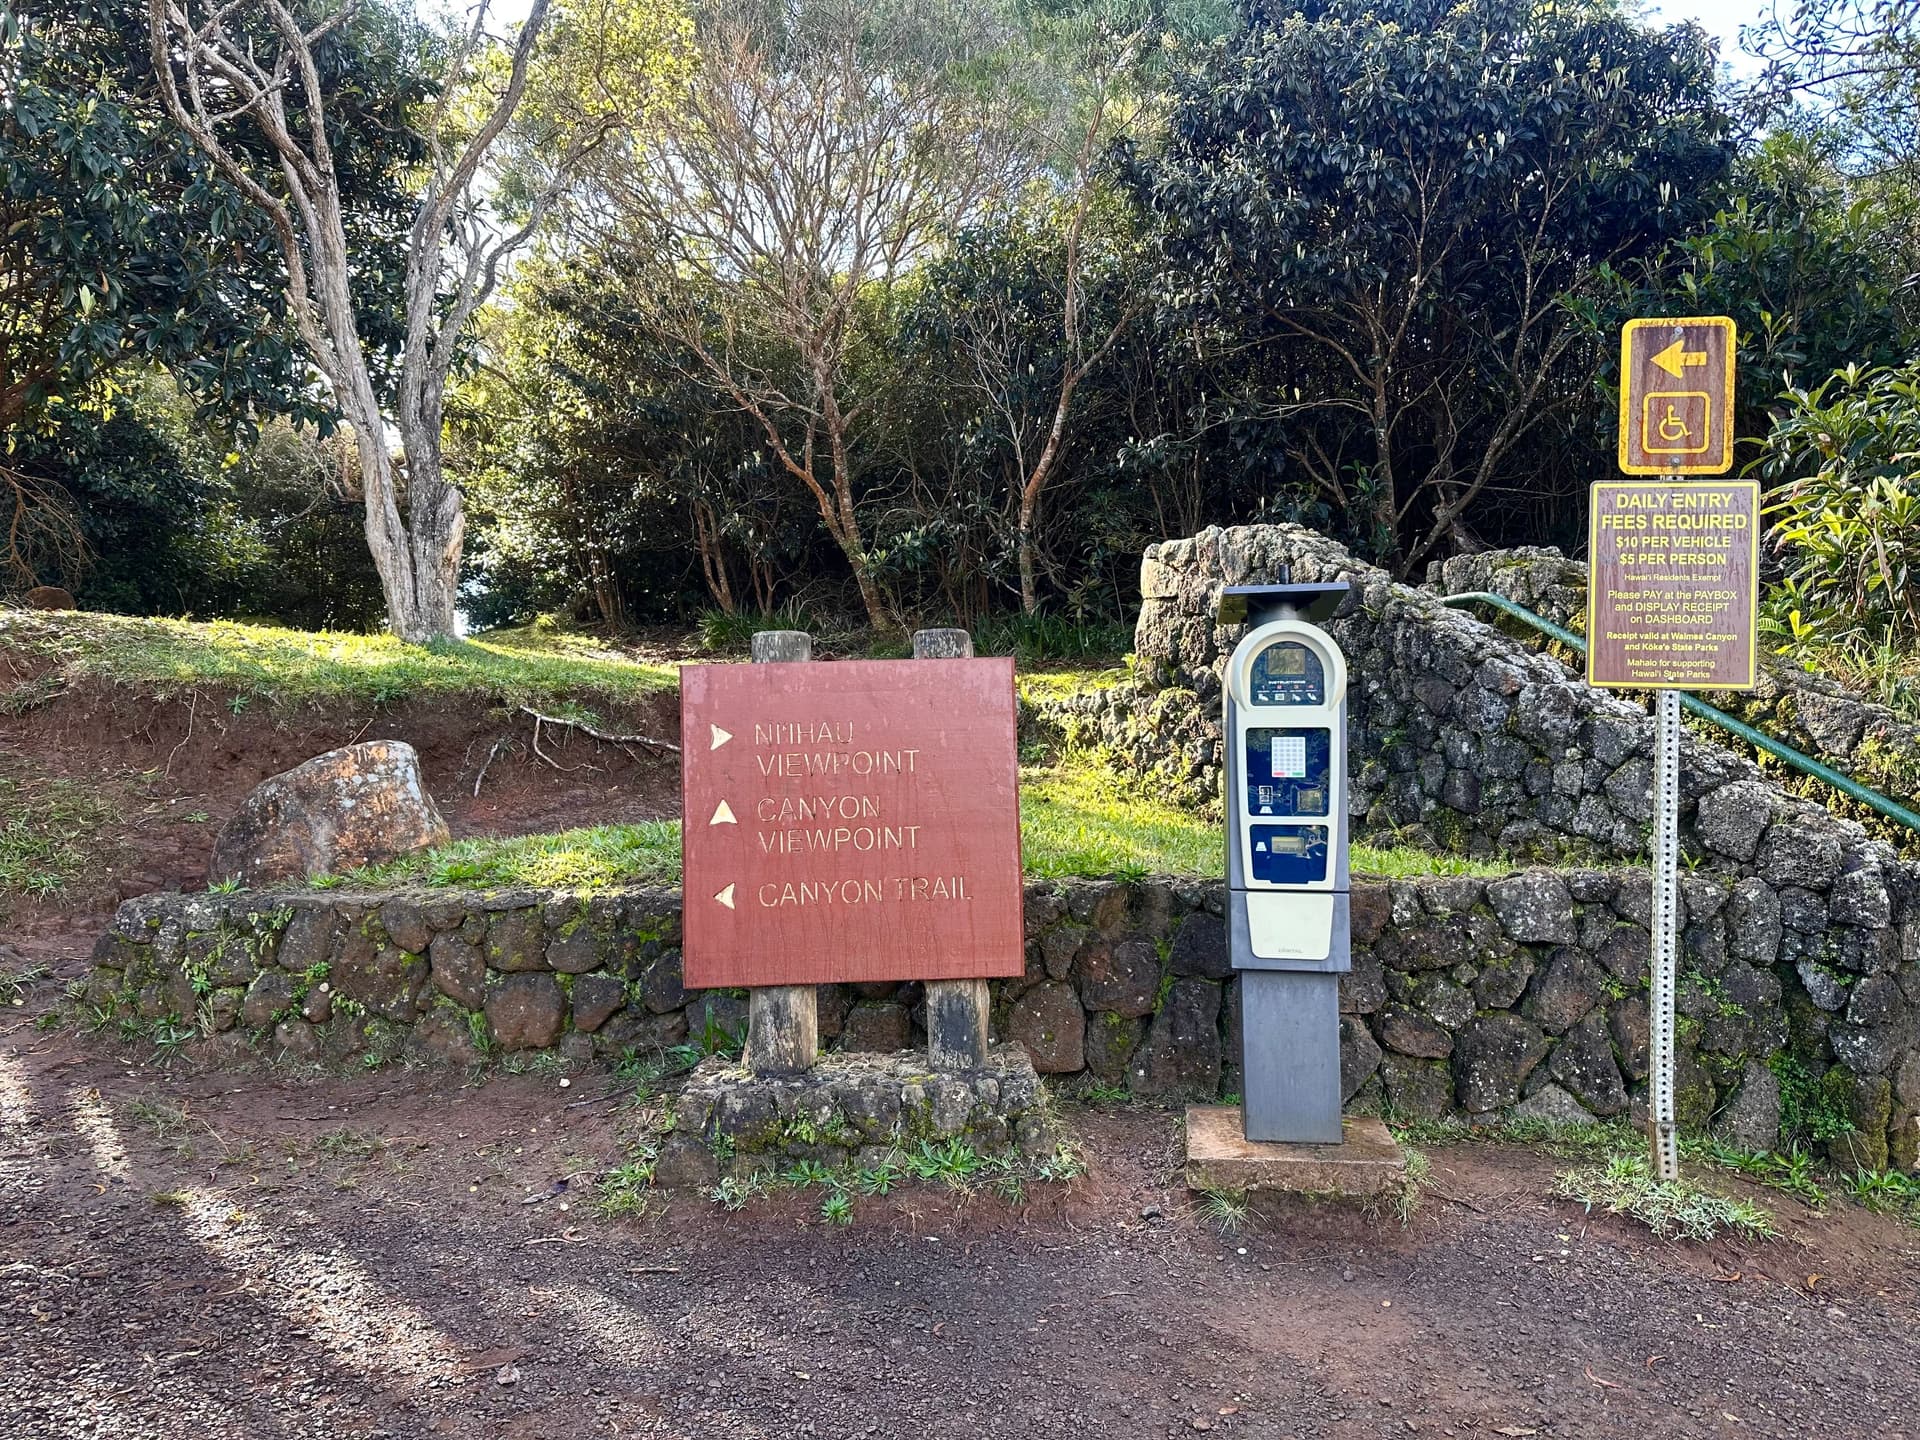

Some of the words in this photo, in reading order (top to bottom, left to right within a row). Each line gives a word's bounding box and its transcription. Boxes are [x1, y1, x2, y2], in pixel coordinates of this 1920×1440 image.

[1616, 493, 1667, 508] DAILY
[1672, 493, 1733, 508] ENTRY
[1602, 514, 1647, 529] FEES
[1652, 514, 1747, 529] REQUIRED
[1616, 535, 1638, 549] $10
[1641, 536, 1670, 548] PER
[1673, 536, 1731, 548] VEHICLE
[1619, 553, 1635, 566] $5
[1638, 553, 1666, 565] PER
[1670, 553, 1727, 565] PERSON
[1692, 574, 1721, 582] Exempt
[1608, 590, 1640, 599] Please
[1643, 590, 1663, 599] PAY
[1664, 591, 1674, 600] at
[1676, 591, 1692, 600] the
[1694, 590, 1737, 600] PAYBOX
[1615, 602, 1633, 612] and
[1635, 602, 1680, 612] DISPLAY
[1682, 602, 1730, 612] RECEIPT
[1630, 616, 1642, 624] on
[1645, 614, 1713, 624] DASHBOARD
[1606, 631, 1638, 641] Receipt
[1639, 632, 1660, 640] valid
[1661, 632, 1670, 640] at
[1671, 633, 1704, 641] Waimea
[1705, 632, 1737, 642] Canyon
[1624, 643, 1640, 651] and
[1671, 643, 1693, 652] State
[1695, 643, 1719, 652] Parks
[1627, 659, 1658, 667] Mahalo
[1659, 659, 1671, 667] for
[1672, 660, 1716, 669] supporting
[1663, 670, 1685, 678] State
[1686, 670, 1711, 678] Parks
[756, 749, 920, 777] VIEWPOINT
[757, 795, 880, 822] CANYON
[758, 825, 921, 853] VIEWPOINT
[758, 878, 883, 907] CANYON
[892, 876, 974, 900] TRAIL
